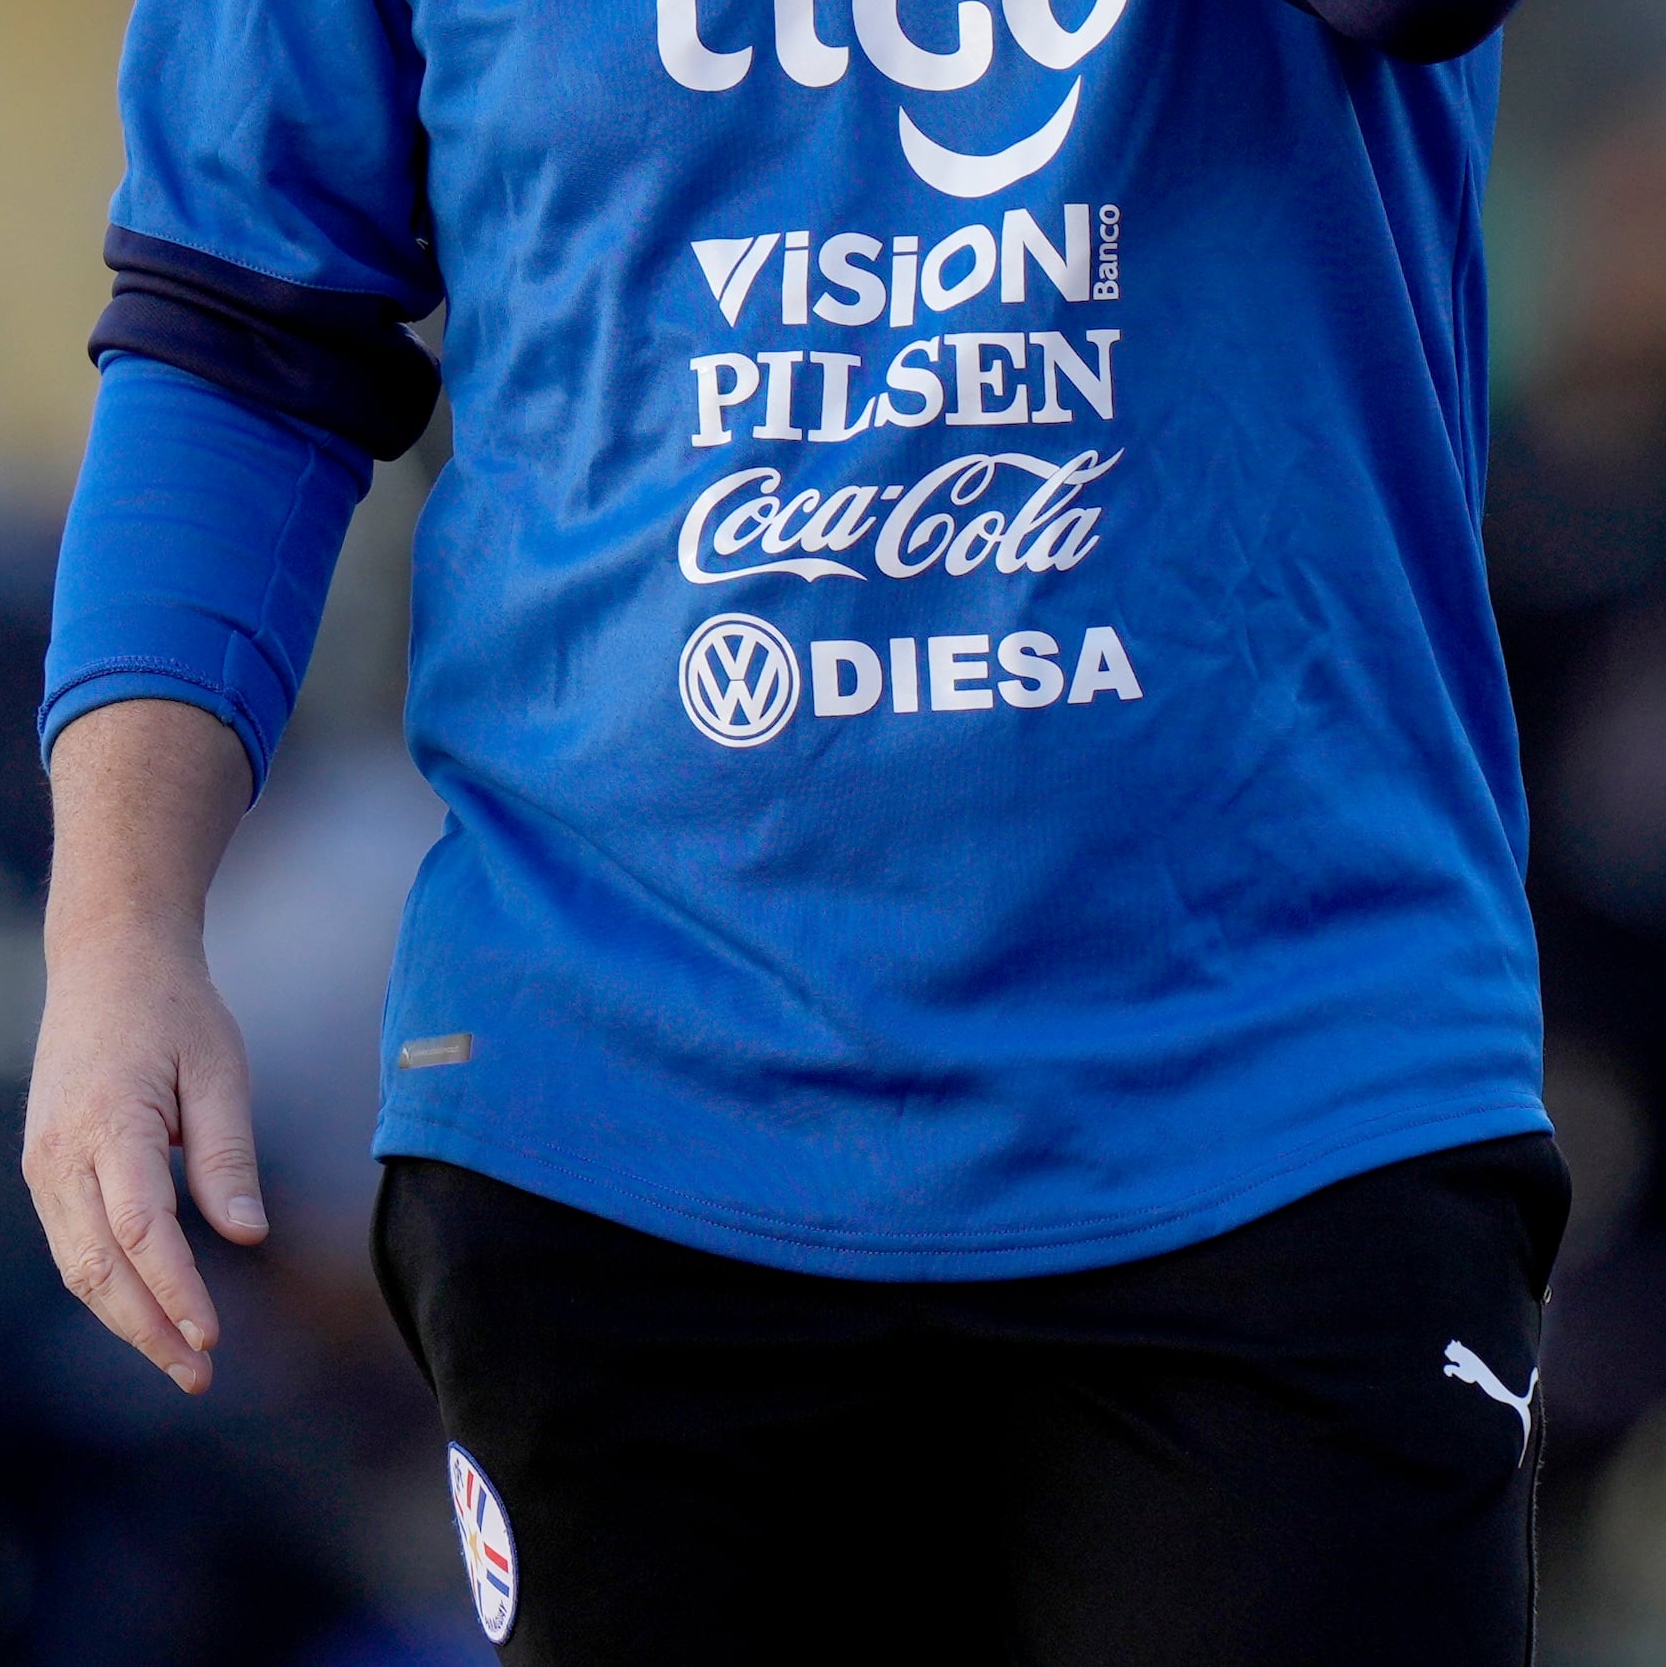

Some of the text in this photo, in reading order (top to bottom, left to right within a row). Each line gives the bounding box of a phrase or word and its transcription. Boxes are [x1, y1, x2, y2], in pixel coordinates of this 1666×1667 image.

[1092, 203, 1120, 301] Banco
[689, 329, 1121, 448] PILSEN
[677, 448, 1124, 585] Coca-Cola
[686, 620, 1144, 740] VW DIESA
